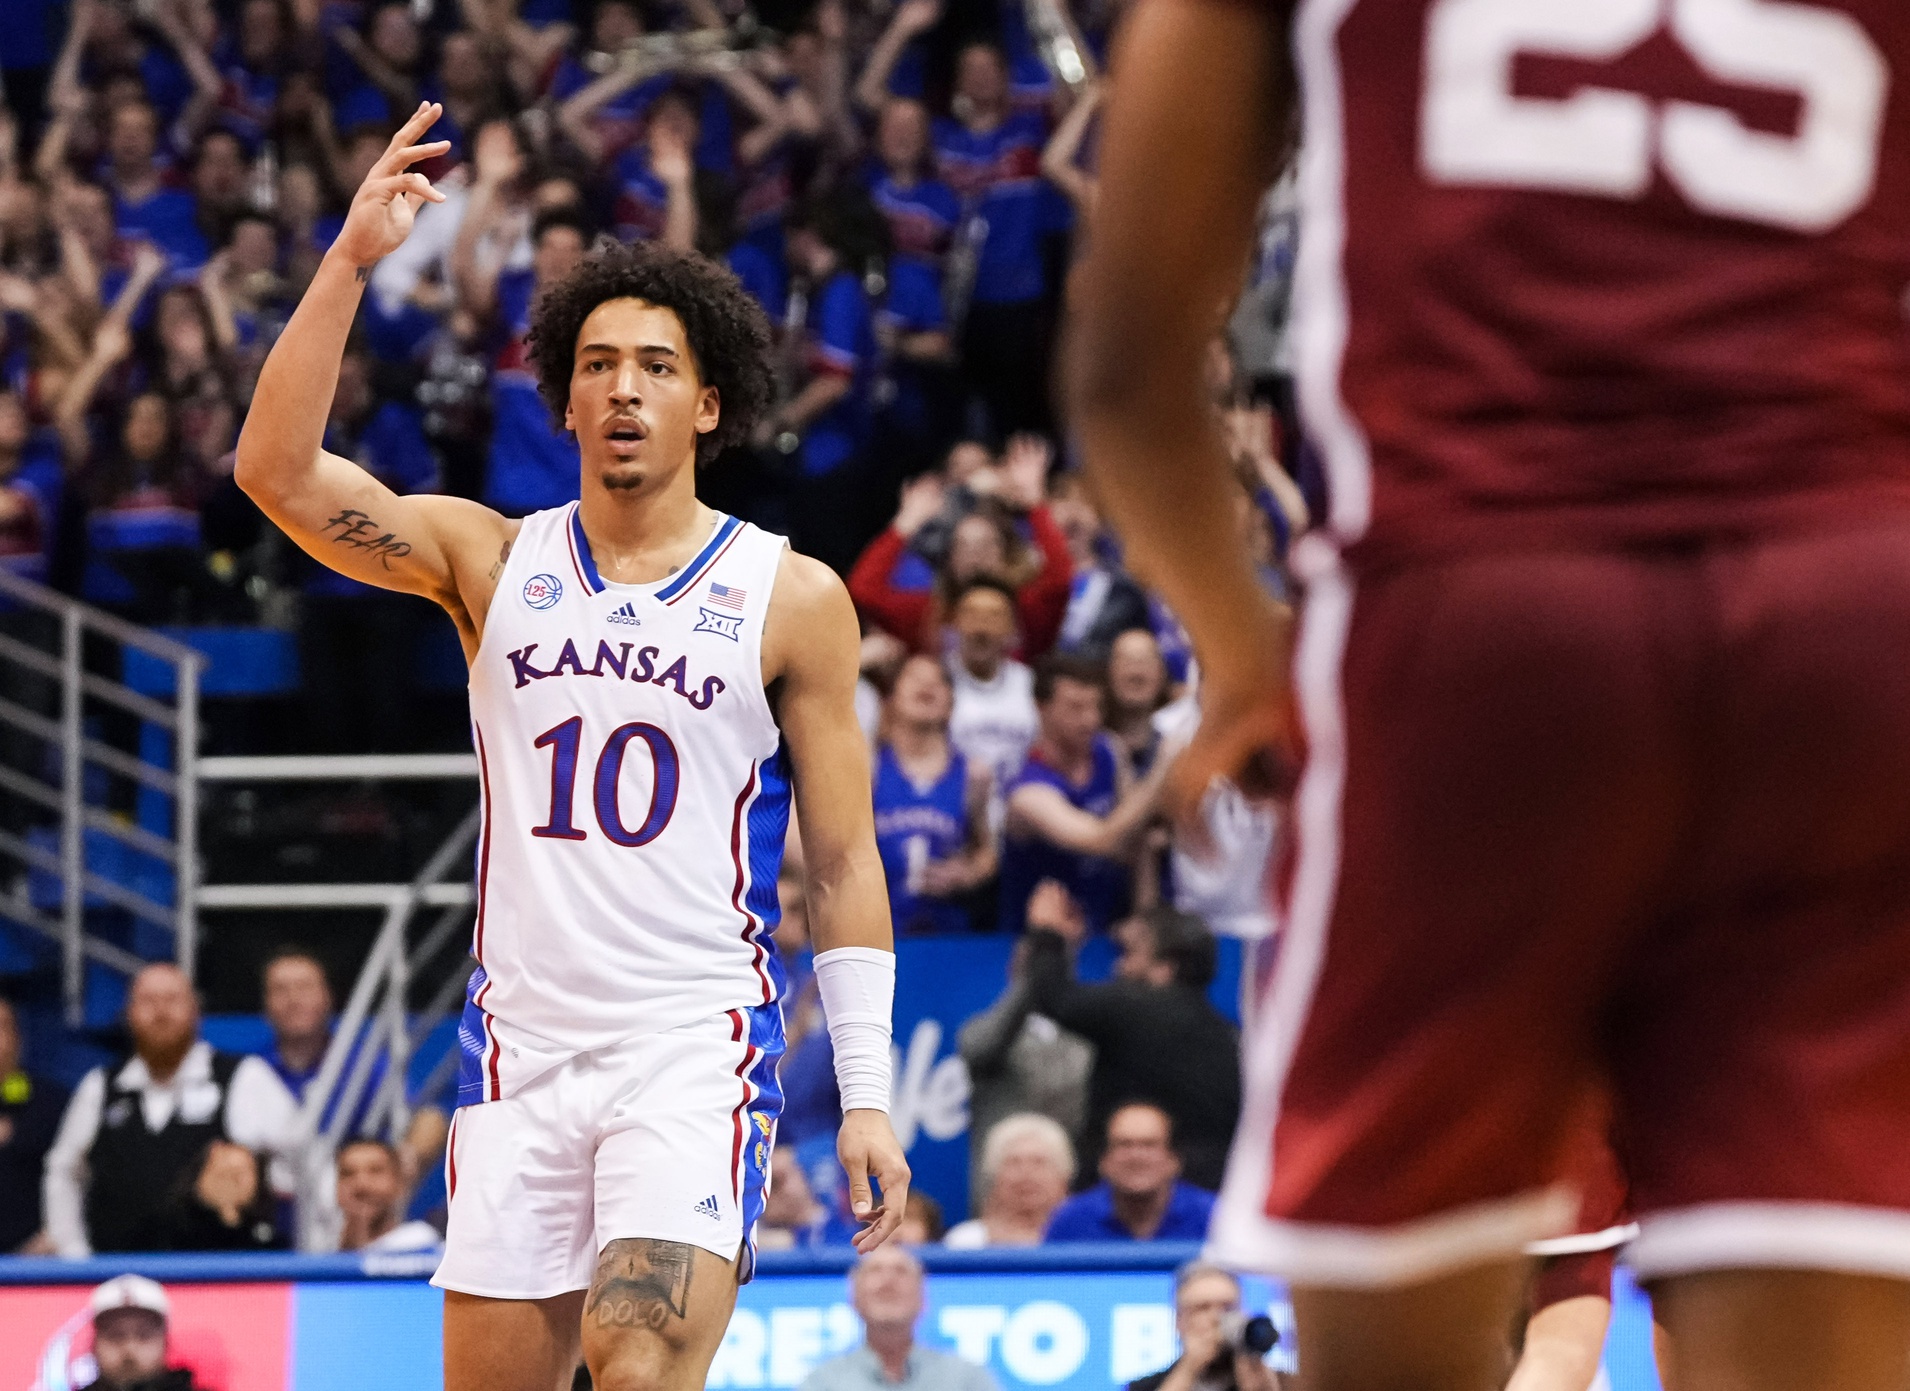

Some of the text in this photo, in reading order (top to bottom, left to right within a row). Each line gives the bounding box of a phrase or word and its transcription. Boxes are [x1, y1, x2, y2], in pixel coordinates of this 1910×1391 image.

[1418, 0, 1893, 236] 25
[320, 509, 412, 571] FEAR
[526, 583, 547, 598] 125
[606, 615, 642, 626] adidas
[507, 637, 726, 711] KANSAS
[531, 715, 680, 847] 10
[597, 1299, 669, 1330] DOLO
[938, 1299, 1088, 1384] TO
